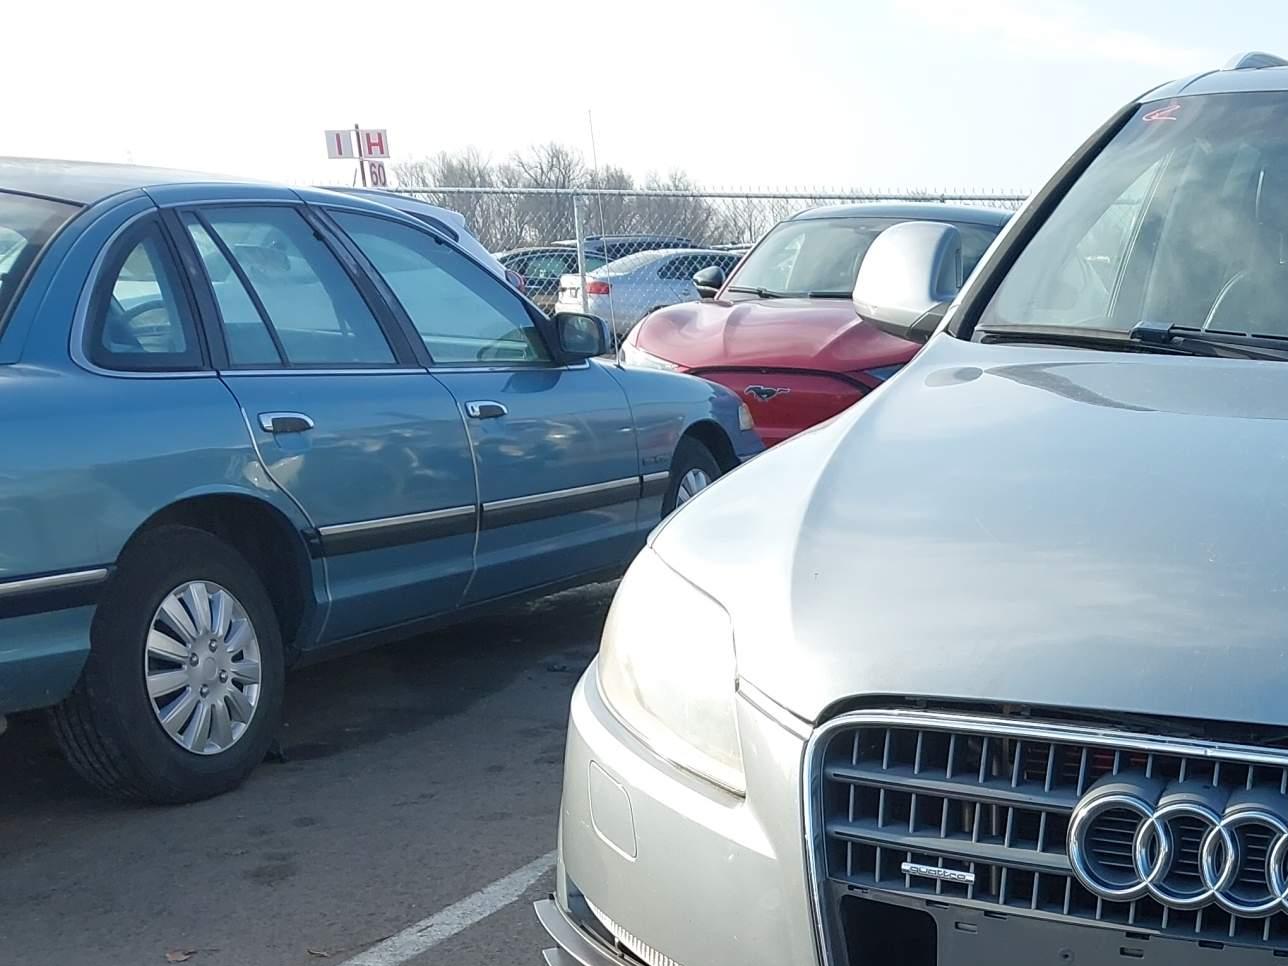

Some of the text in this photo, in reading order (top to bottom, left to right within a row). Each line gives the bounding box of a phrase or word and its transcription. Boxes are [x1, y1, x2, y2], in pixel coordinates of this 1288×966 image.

[365, 132, 385, 155] H
[369, 162, 387, 187] 60
[909, 865, 967, 881] quattro
